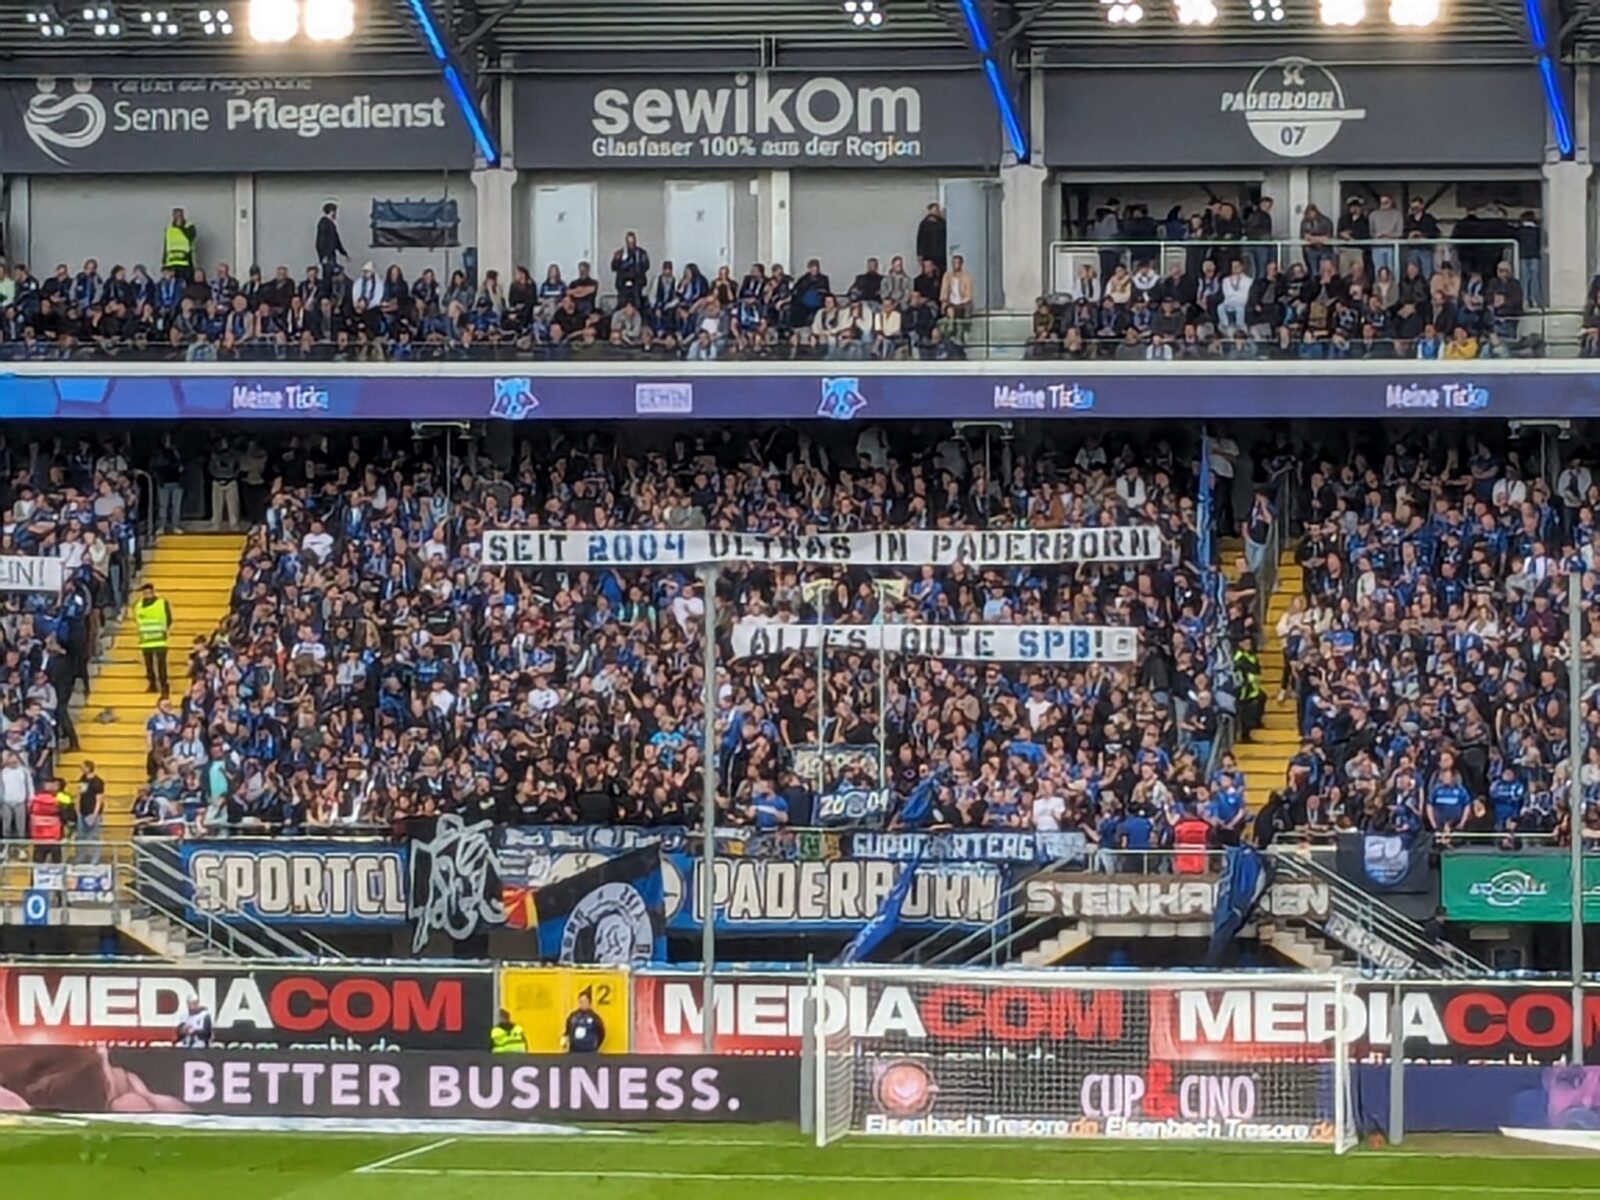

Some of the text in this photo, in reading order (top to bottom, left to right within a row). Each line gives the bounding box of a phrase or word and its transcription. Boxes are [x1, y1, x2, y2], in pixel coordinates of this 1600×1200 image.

[113, 96, 445, 137] Senne Pflegedienst
[592, 74, 921, 135] sewikOm
[1221, 91, 1334, 111] PADERBORN
[592, 136, 921, 161] Glasfaser 100% aus der Region
[1281, 126, 1308, 145] 07
[233, 384, 282, 409] Meine
[994, 383, 1045, 409] Meine
[1386, 383, 1440, 409] Meine
[488, 529, 1150, 562] SEIT 2004 ULTRAS IN PADERBORN
[750, 626, 1104, 657] ALLES GUTE SPB!
[192, 853, 406, 914] SPORTCL
[1026, 880, 1329, 917] STEINHAEN
[18, 975, 463, 1033] MEDIACOM
[663, 983, 1123, 1041] MEDIACOM
[183, 1061, 741, 1111] BETTER BUSINESS.
